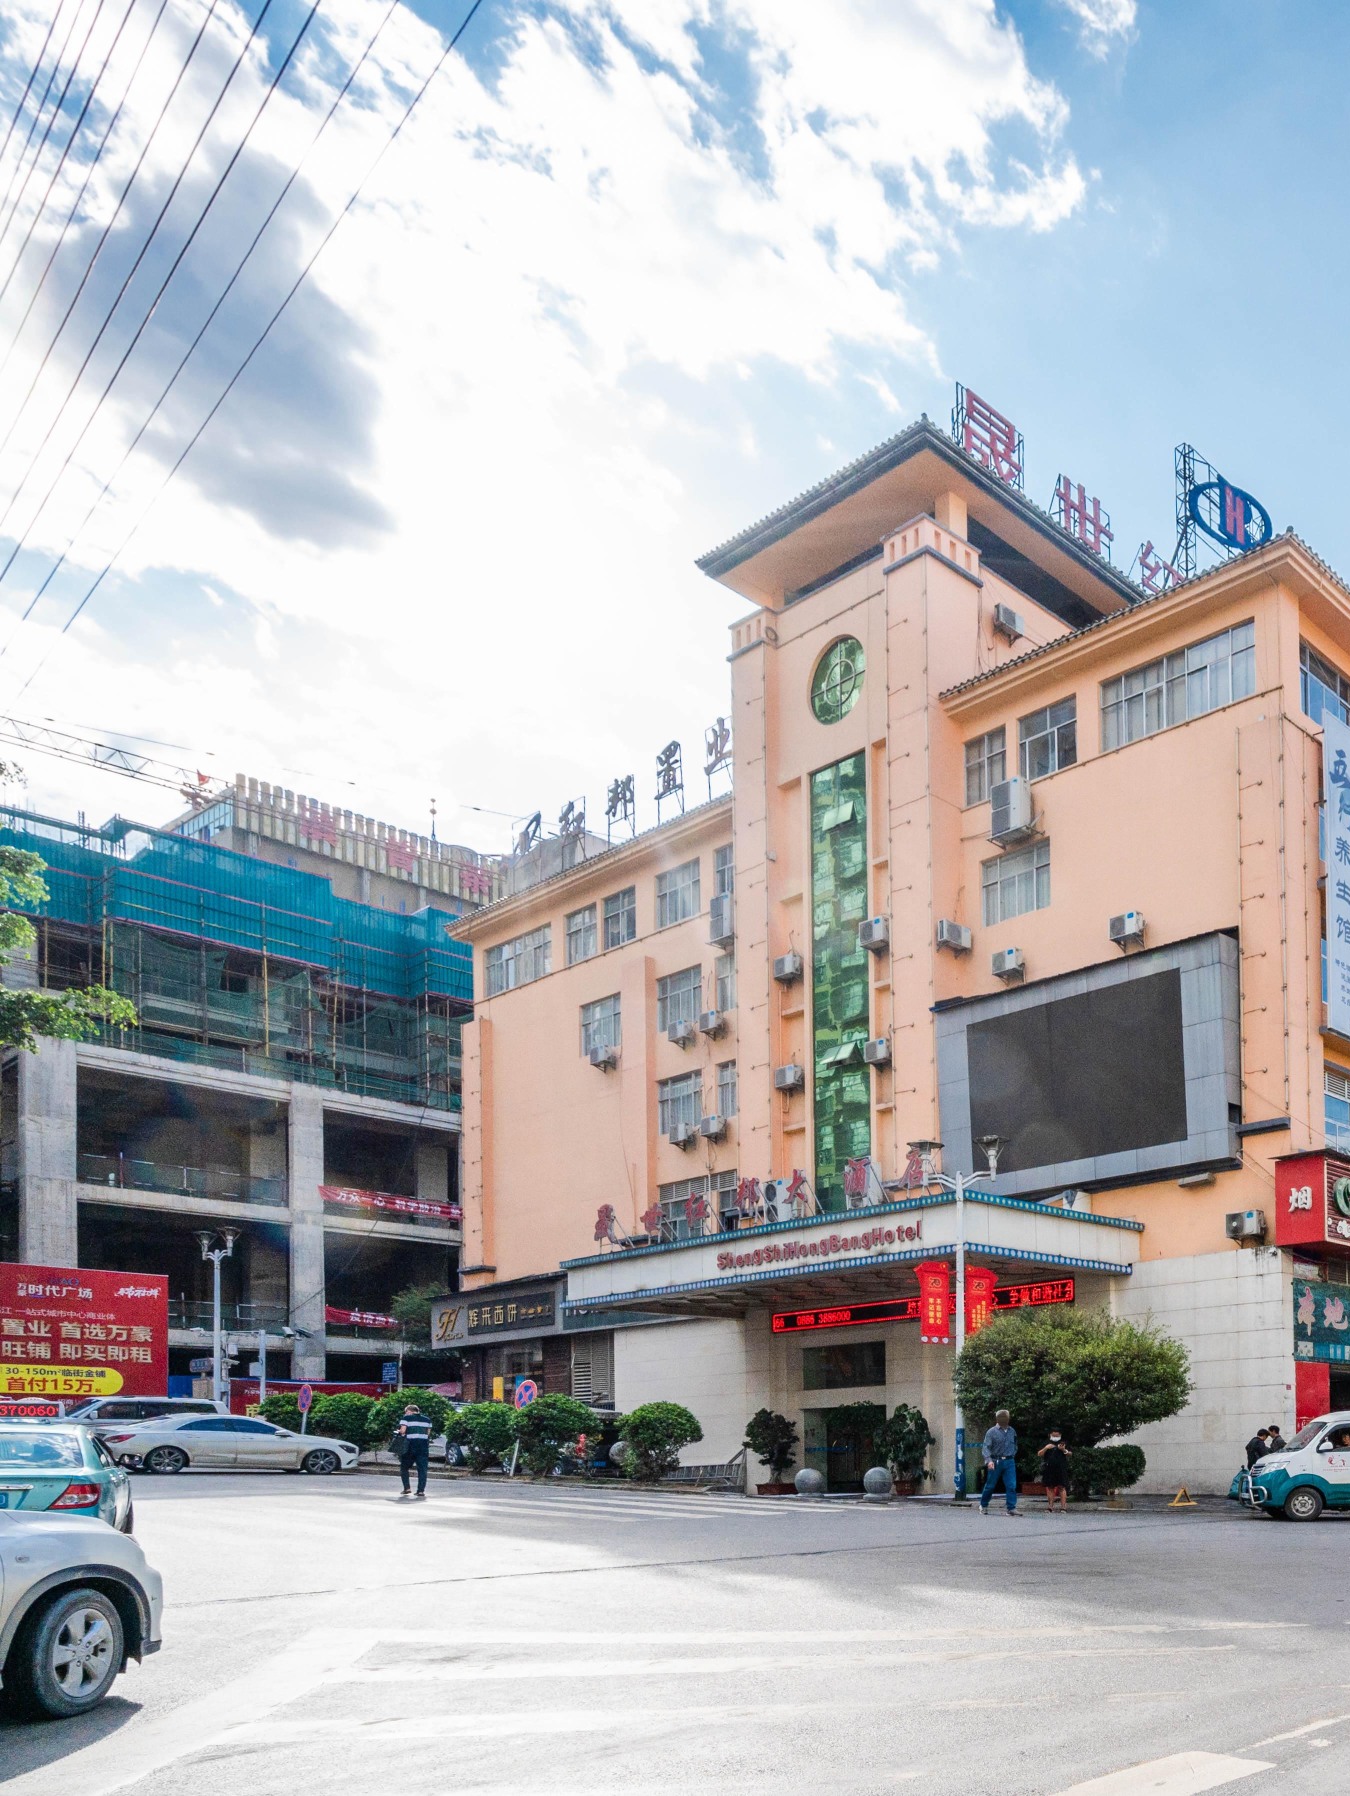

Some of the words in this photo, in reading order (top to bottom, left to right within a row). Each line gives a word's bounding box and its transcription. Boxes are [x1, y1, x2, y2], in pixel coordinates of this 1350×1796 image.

[1288, 1186, 1313, 1213] 烟
[716, 1220, 923, 1270] ShengShiHongBangHotel
[28, 1284, 93, 1301] 时代广场
[0, 1306, 12, 1315] 江
[16, 1308, 116, 1320] 一站式城市中心商业体
[2, 1318, 51, 1337] 置业
[60, 1321, 153, 1342] 首选万豪
[2, 1341, 51, 1359] 旺铺
[60, 1343, 152, 1363] 即买即租
[0, 1405, 59, 1417] 370060
